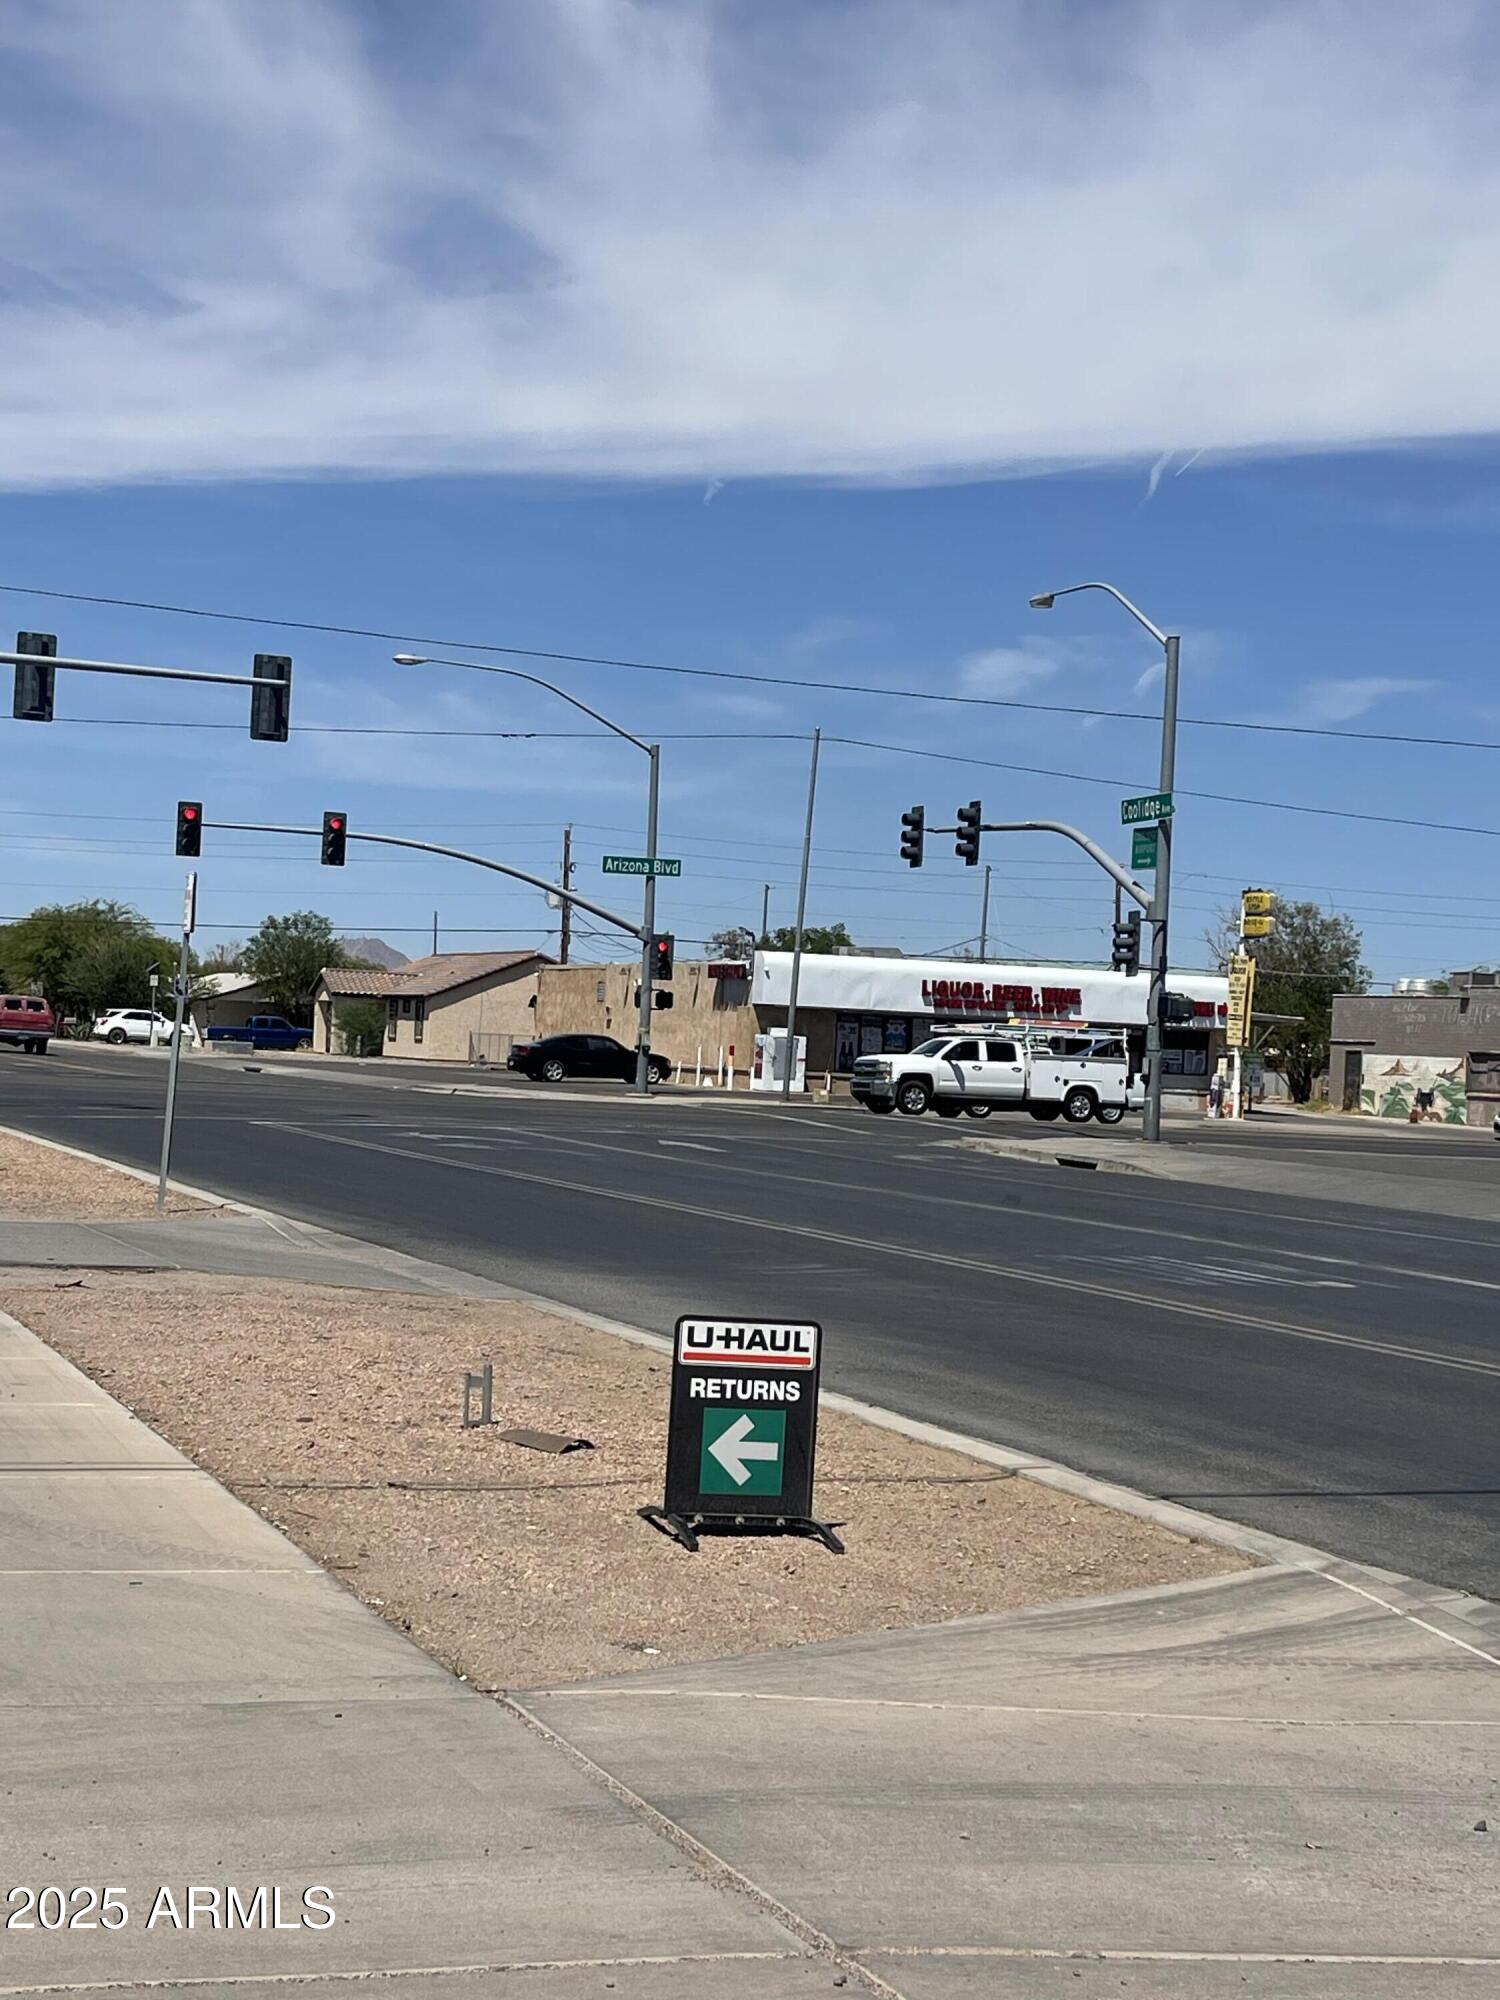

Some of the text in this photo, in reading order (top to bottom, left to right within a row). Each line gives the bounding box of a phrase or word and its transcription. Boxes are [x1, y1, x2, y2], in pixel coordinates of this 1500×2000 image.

[1122, 799, 1160, 820] Coolidge
[605, 858, 679, 875] Arizona Blvd
[921, 979, 1082, 1005] LIQUOR BEER WINE
[687, 1325, 810, 1353] U-HAUL
[689, 1377, 801, 1402] RETURNS
